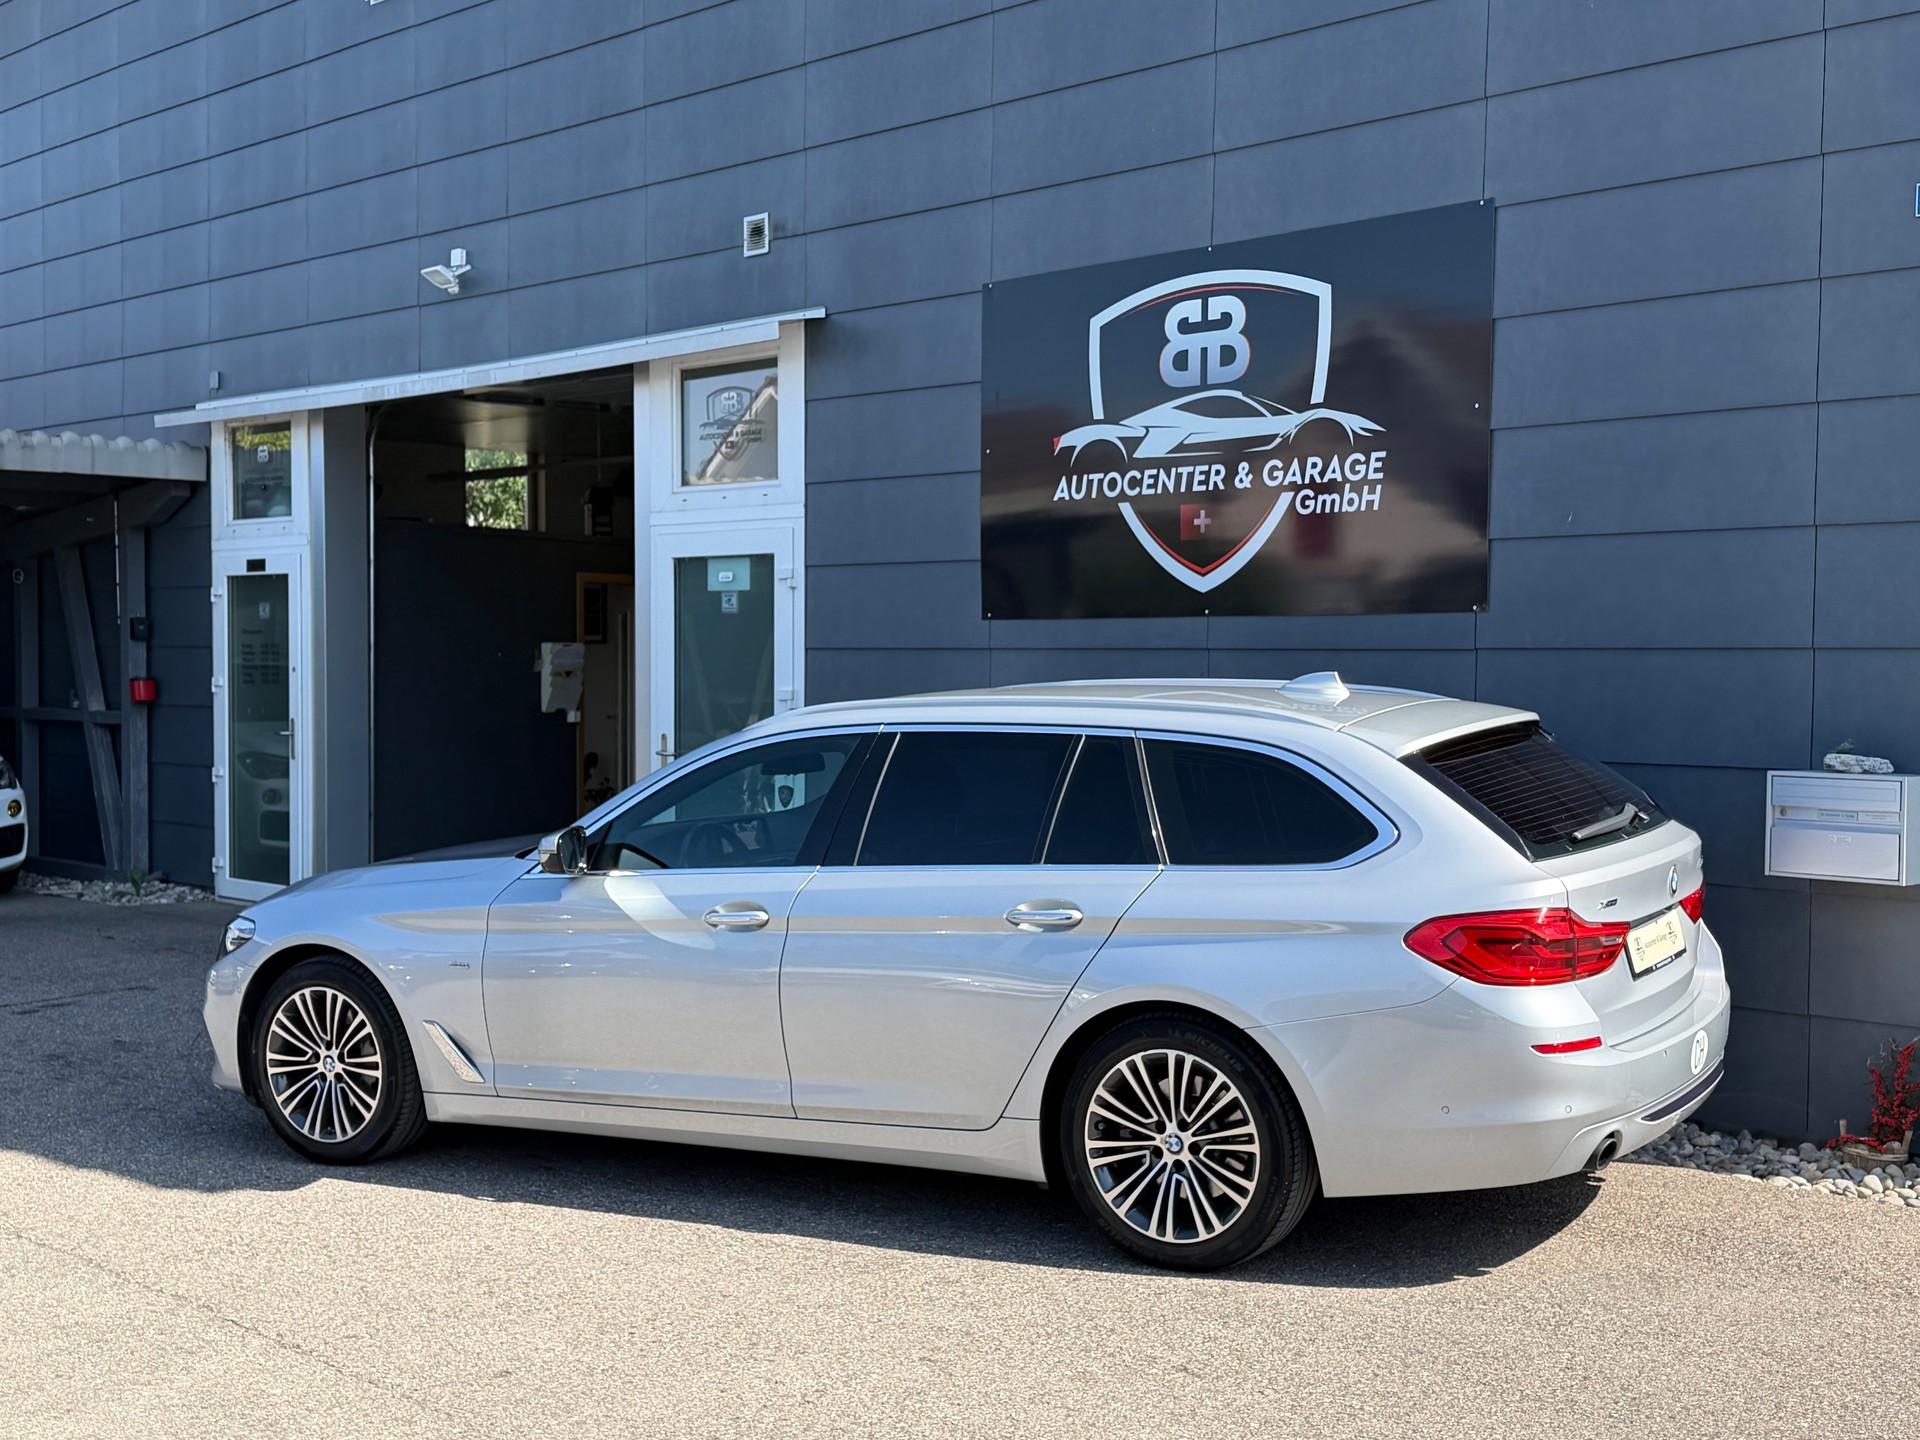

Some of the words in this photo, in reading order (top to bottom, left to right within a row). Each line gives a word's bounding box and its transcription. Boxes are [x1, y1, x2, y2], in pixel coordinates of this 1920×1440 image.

[699, 431, 733, 441] AUTOCEN
[1053, 464, 1226, 501] AUTOCENTER
[1234, 461, 1254, 489] &
[1262, 451, 1387, 487] GARAGE
[1295, 483, 1382, 515] GmbH
[1694, 1035, 1705, 1070] CH
